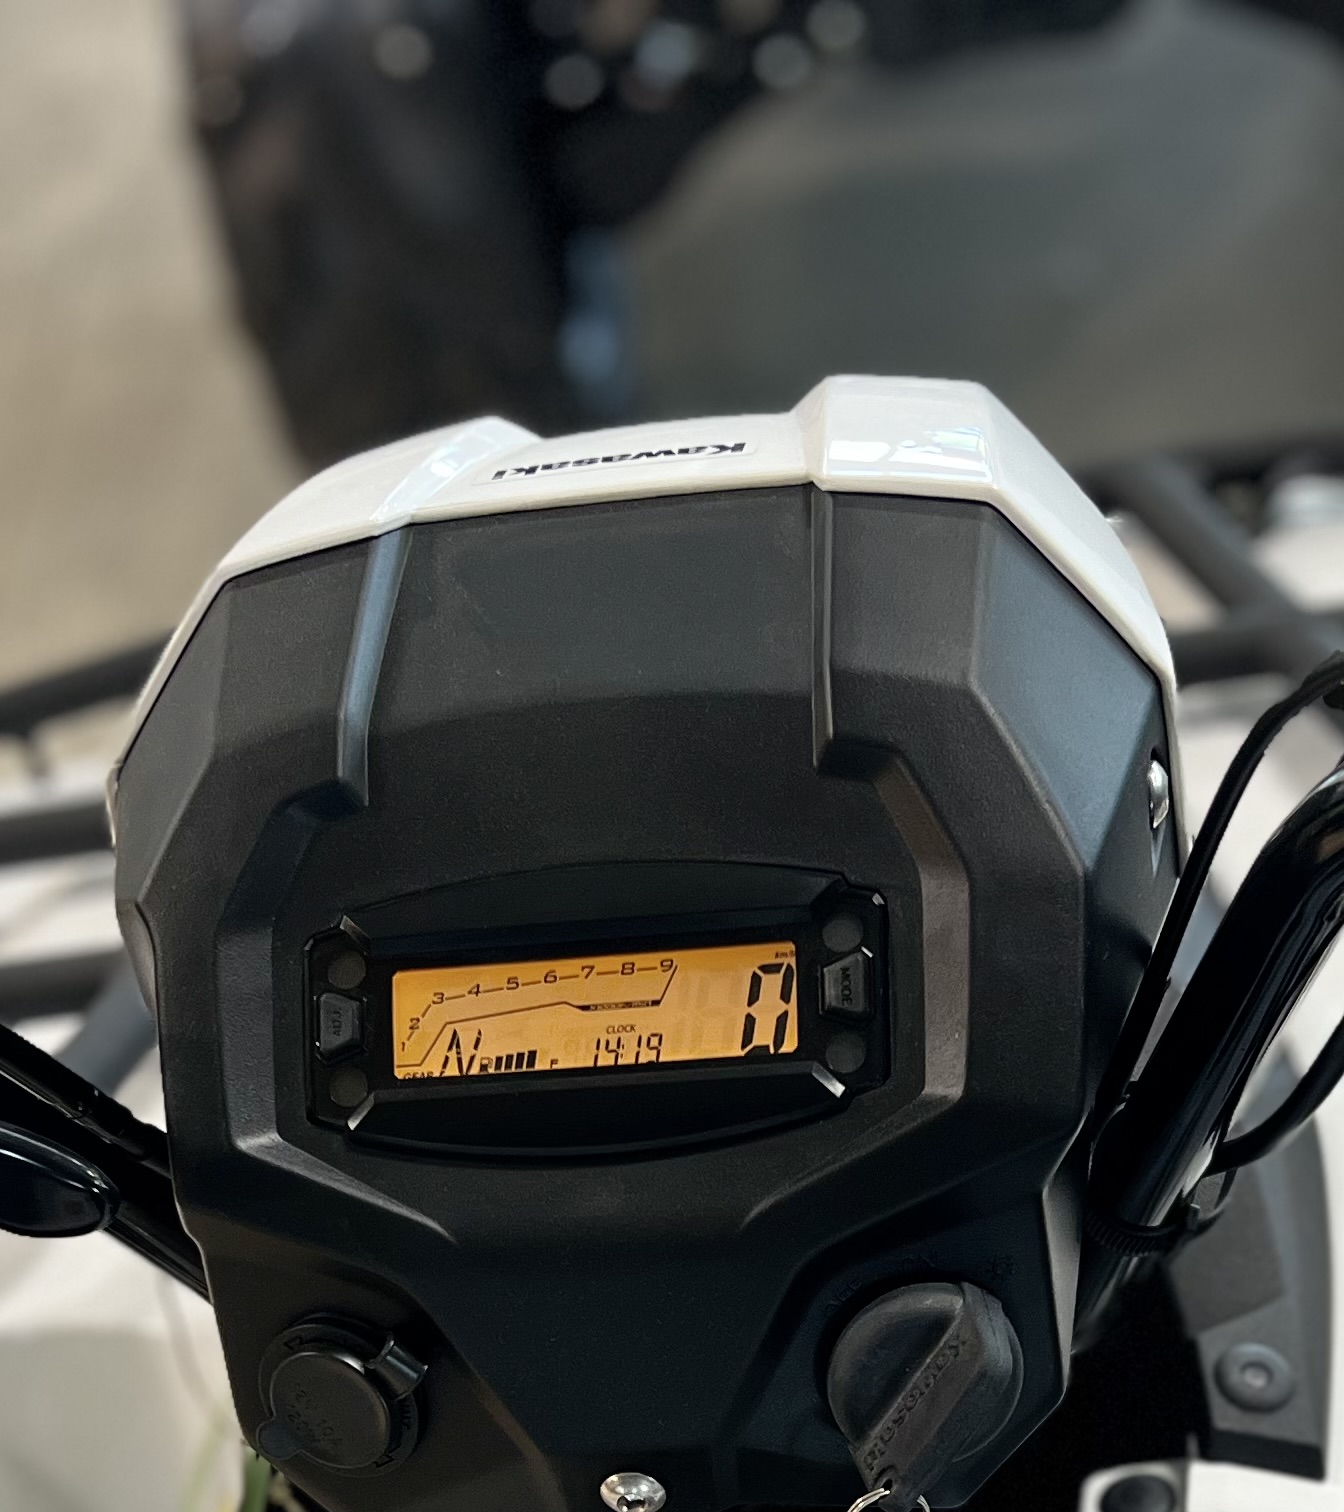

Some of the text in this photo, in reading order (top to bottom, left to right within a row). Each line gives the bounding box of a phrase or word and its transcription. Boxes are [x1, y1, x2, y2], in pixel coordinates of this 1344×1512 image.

[492, 442, 745, 480] Kawasaki
[409, 1017, 420, 1030] 2
[432, 992, 445, 1004] 3
[467, 983, 481, 997] 4
[506, 976, 520, 990] 5
[543, 970, 557, 984] 6
[581, 965, 595, 980] 7
[621, 962, 636, 976] 8
[660, 959, 674, 973] 9
[840, 967, 852, 1006] MODE
[606, 1024, 637, 1034] CLOCK
[440, 1028, 482, 1076] N
[593, 1033, 663, 1067] 14:19
